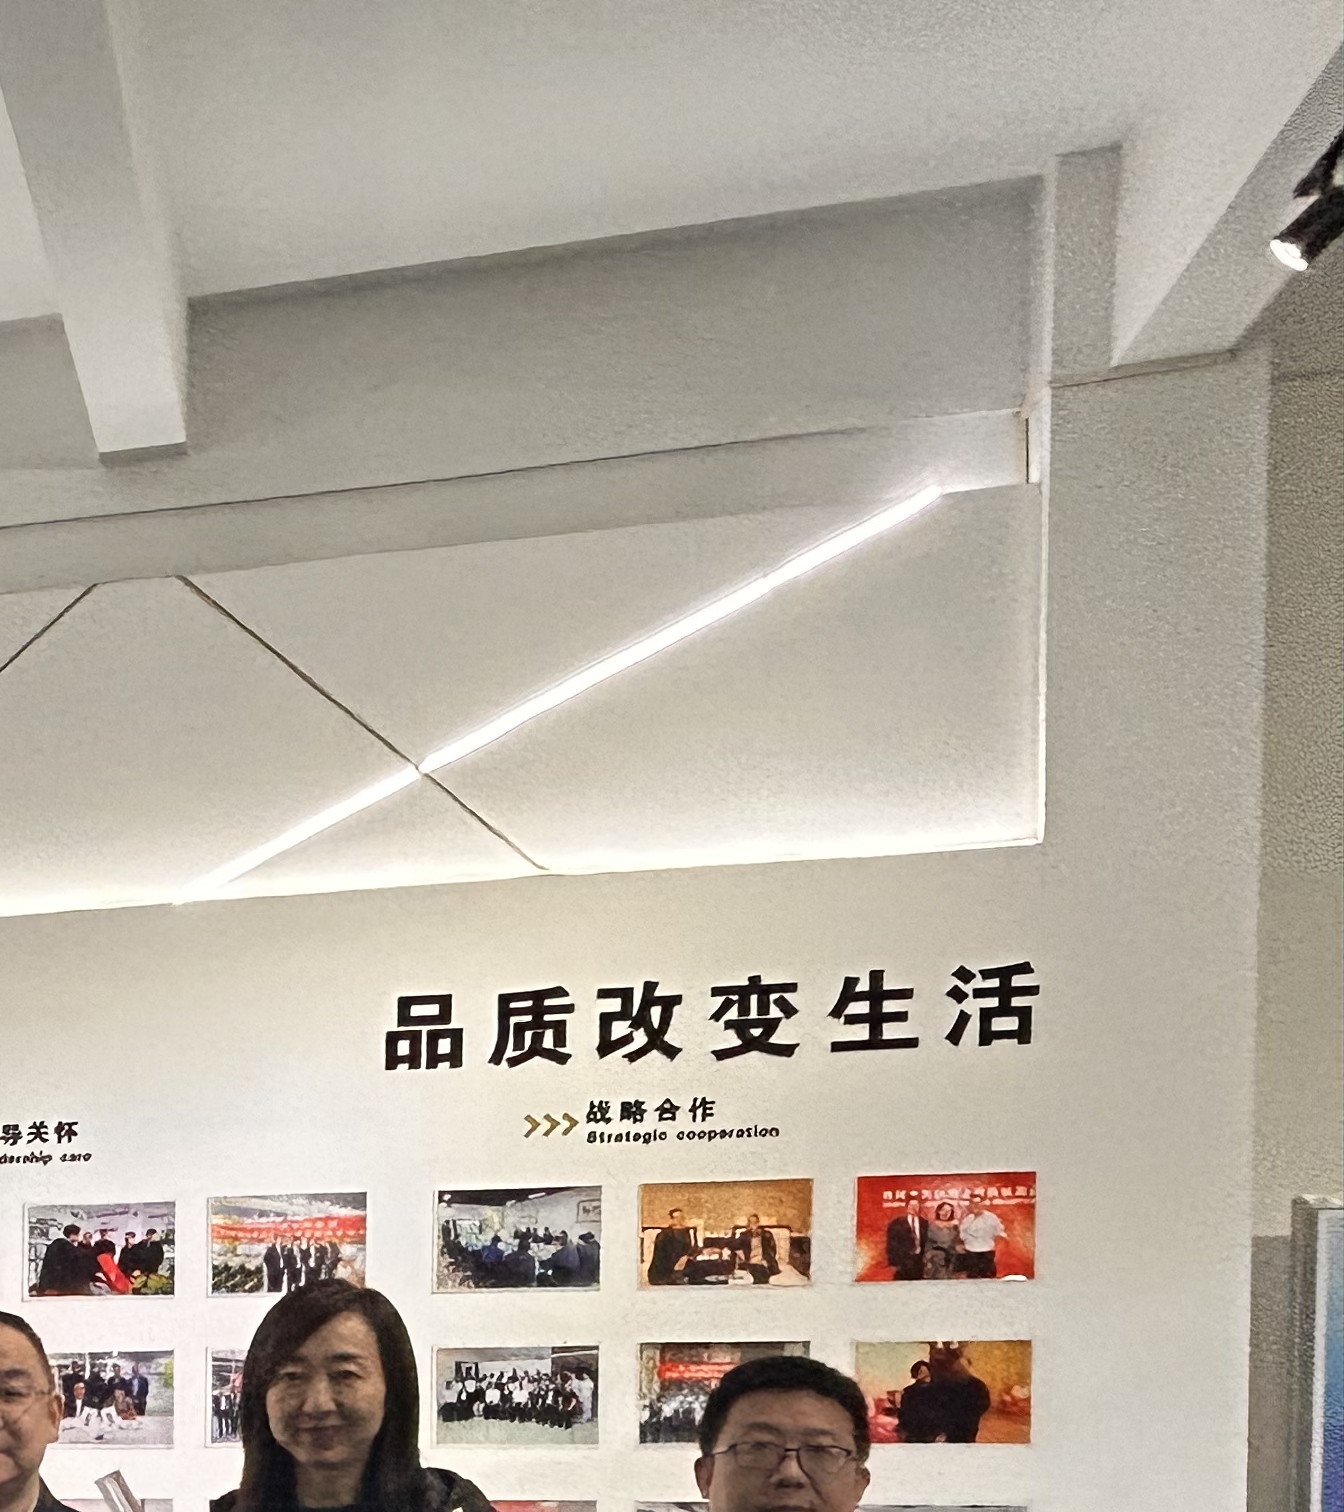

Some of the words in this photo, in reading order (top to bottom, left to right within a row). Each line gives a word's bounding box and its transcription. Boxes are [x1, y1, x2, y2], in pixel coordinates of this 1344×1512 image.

[384, 961, 1041, 1070] 品质改变生活
[585, 1096, 716, 1125] 战略合作
[586, 1129, 668, 1144] Strategic
